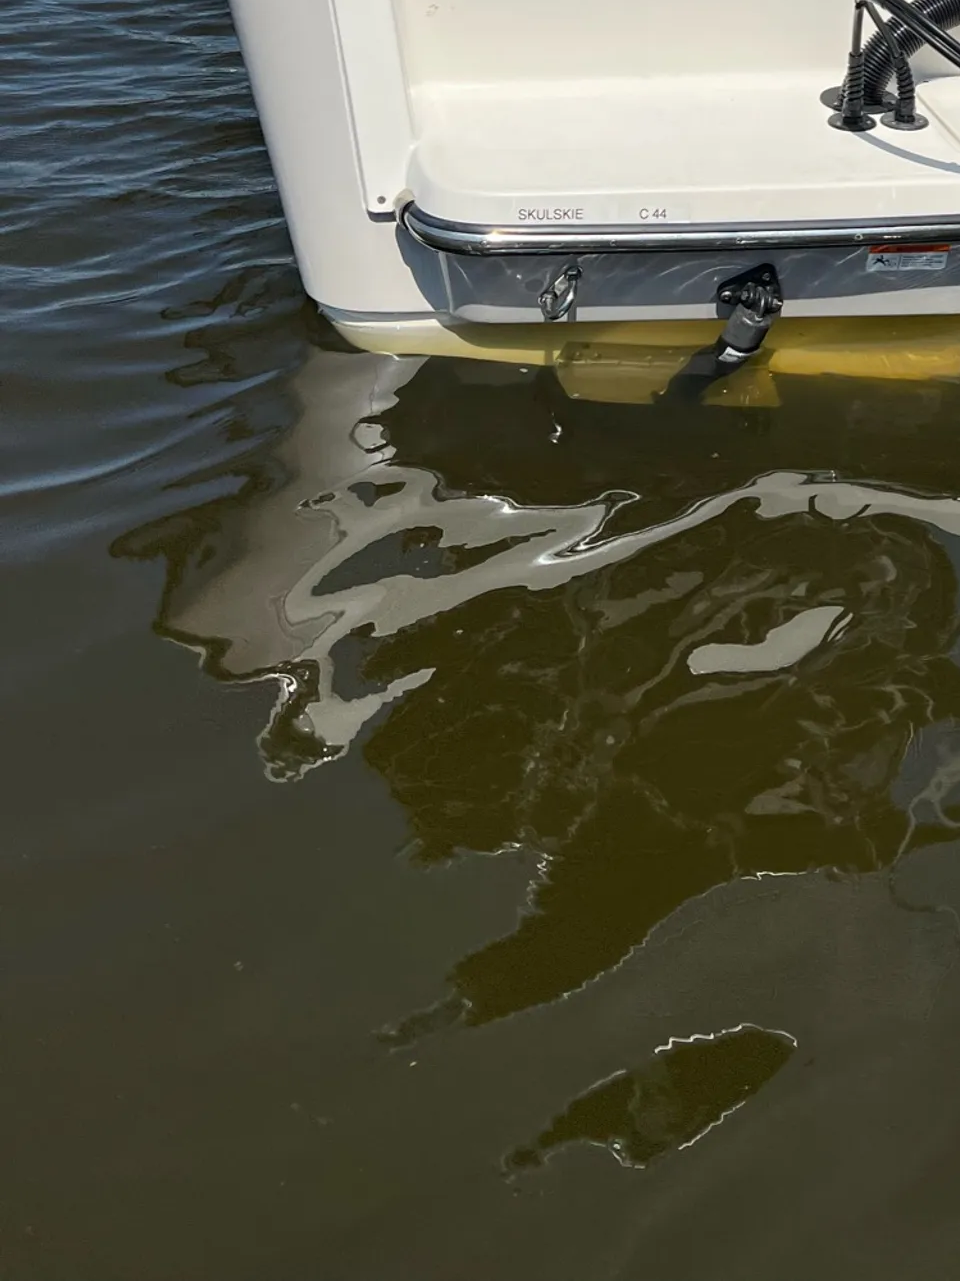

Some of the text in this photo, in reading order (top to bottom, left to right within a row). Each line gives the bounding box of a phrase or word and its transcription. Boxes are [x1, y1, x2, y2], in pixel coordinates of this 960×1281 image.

[517, 208, 667, 220] SKULSKIE C 44
